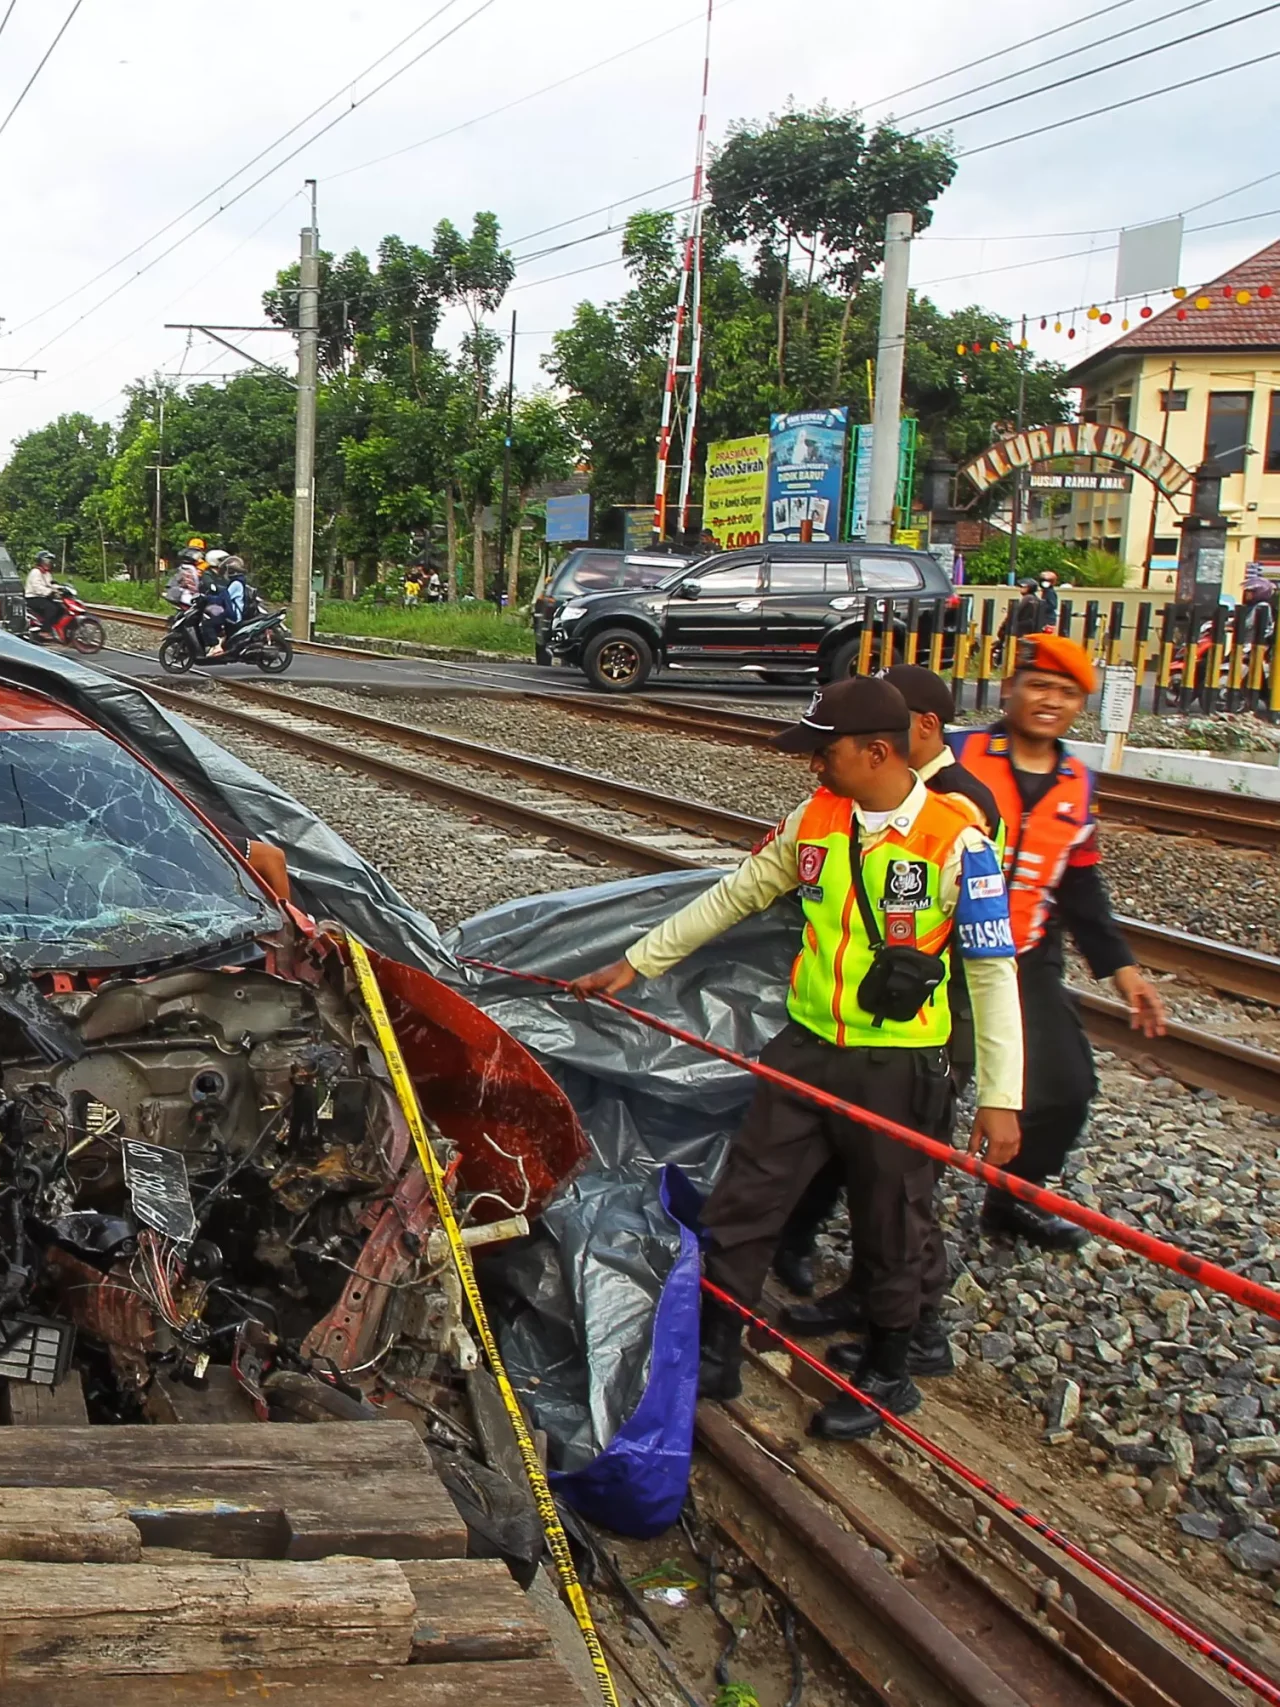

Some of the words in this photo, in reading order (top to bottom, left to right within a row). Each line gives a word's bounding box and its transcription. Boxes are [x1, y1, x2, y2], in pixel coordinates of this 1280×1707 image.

[1029, 475, 1063, 488] DUSUN
[1064, 475, 1098, 489] RAMAH
[1099, 476, 1126, 490] ANAK
[126, 1142, 164, 1163] SP
[136, 1199, 170, 1228] H
